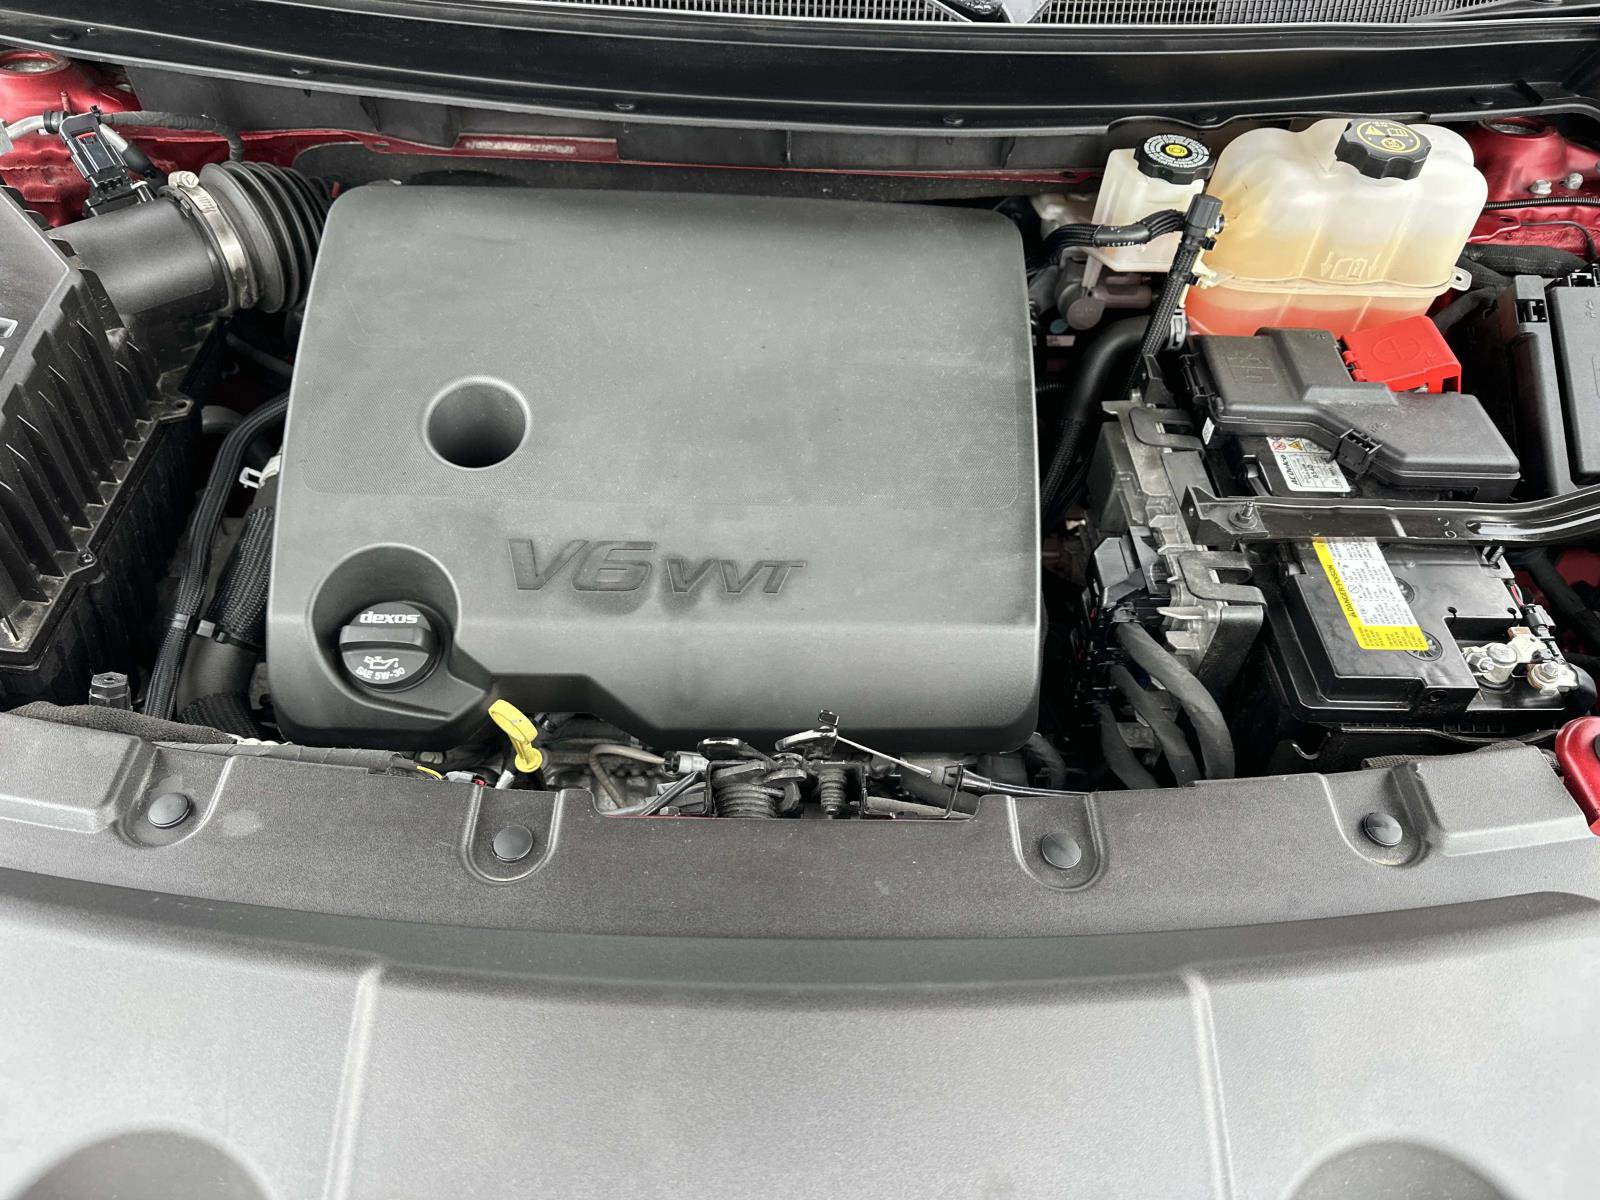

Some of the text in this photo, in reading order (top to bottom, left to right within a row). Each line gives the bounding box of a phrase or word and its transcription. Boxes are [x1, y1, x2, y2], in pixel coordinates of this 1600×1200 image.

[507, 538, 806, 594] V6 VVT
[359, 611, 421, 624] dexos
[355, 665, 406, 681] SAE 5W-30
